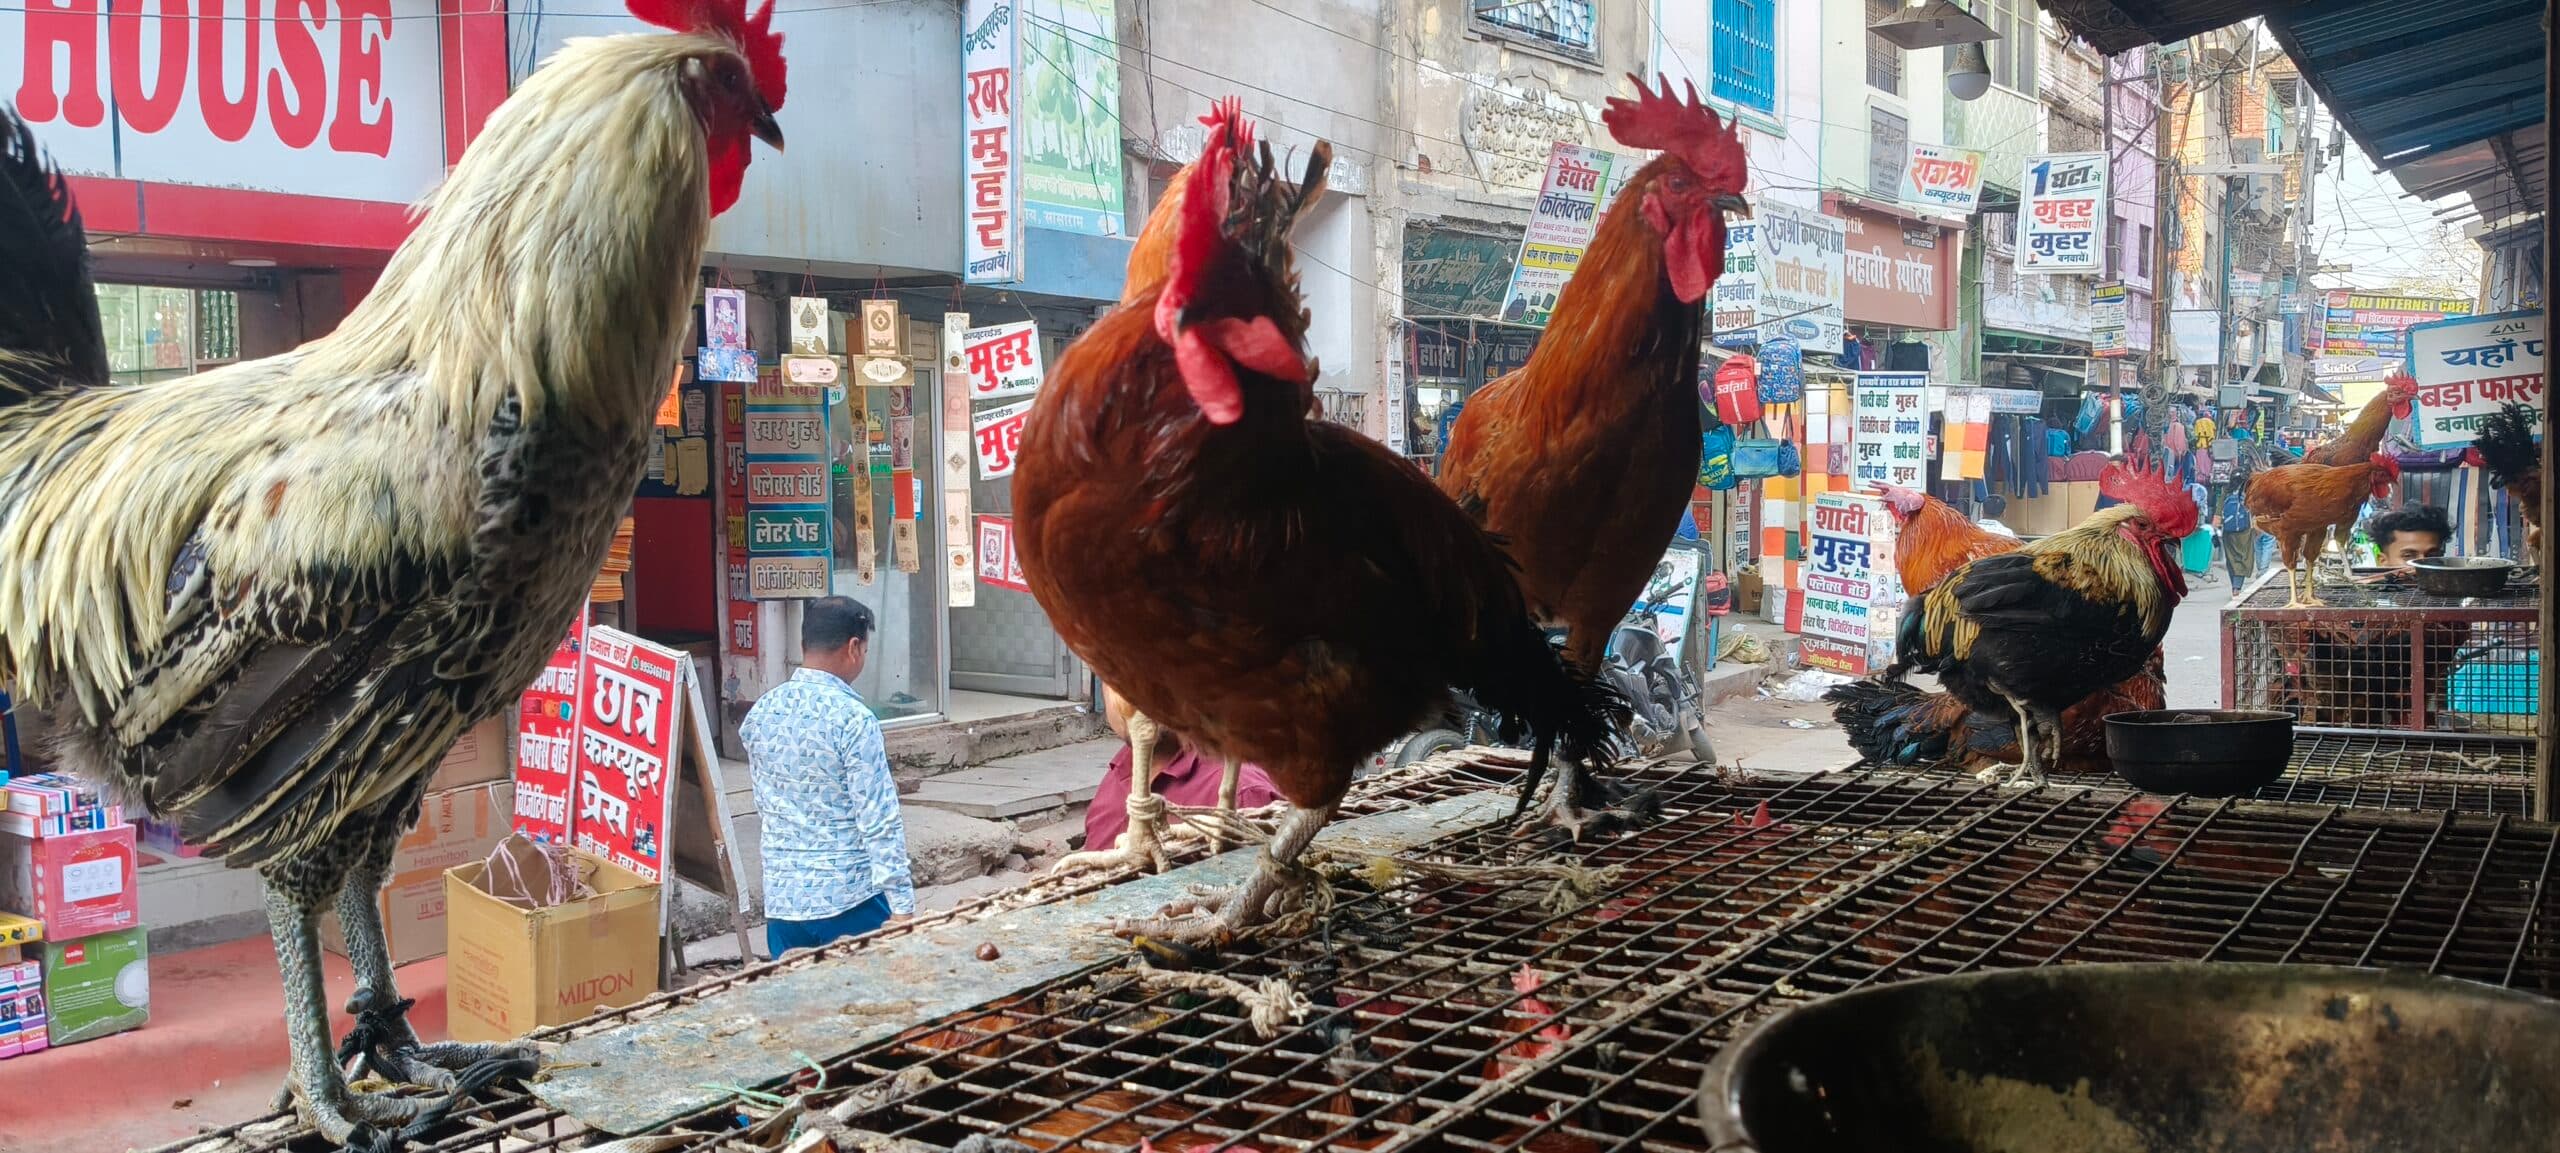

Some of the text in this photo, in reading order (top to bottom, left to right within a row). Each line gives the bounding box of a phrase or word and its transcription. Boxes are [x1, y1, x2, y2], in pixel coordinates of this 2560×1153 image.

[16, 0, 393, 158] HOUSE
[967, 67, 1010, 119] रबर
[1910, 151, 1980, 194] राजश्री
[2031, 161, 2051, 197] 1
[2051, 164, 2093, 188] घंटा
[2033, 199, 2095, 224] मुहर
[1760, 210, 1800, 256] राजश्री
[2029, 232, 2092, 256] मुहर
[1845, 245, 1891, 290] महावीर
[2350, 296, 2373, 309] RAJ
[2376, 297, 2435, 312] INTERNET
[2439, 301, 2470, 313] CAFE
[965, 329, 1032, 391] मुहर
[2322, 362, 2358, 374] Sudha
[1717, 379, 1748, 394] safari
[1895, 395, 1918, 412] मुहर
[2418, 380, 2475, 411] बड़ा
[751, 418, 820, 449] रबर मुहर
[976, 409, 1031, 472] मुह
[1858, 443, 1882, 460] मुहर
[798, 466, 822, 496] बोर्ड
[1893, 467, 1917, 484] मुहर
[755, 516, 792, 543] लेटर
[793, 516, 820, 543] पैड
[1816, 503, 1868, 535] शादी
[1812, 534, 1871, 572] मुहर
[800, 562, 824, 590] कार्ड
[734, 612, 753, 649] कार्ड
[594, 663, 662, 744] छात्र
[583, 726, 663, 800] कम्प्यूटर
[581, 770, 629, 839] प्रेस
[557, 969, 634, 1009] MILTON
